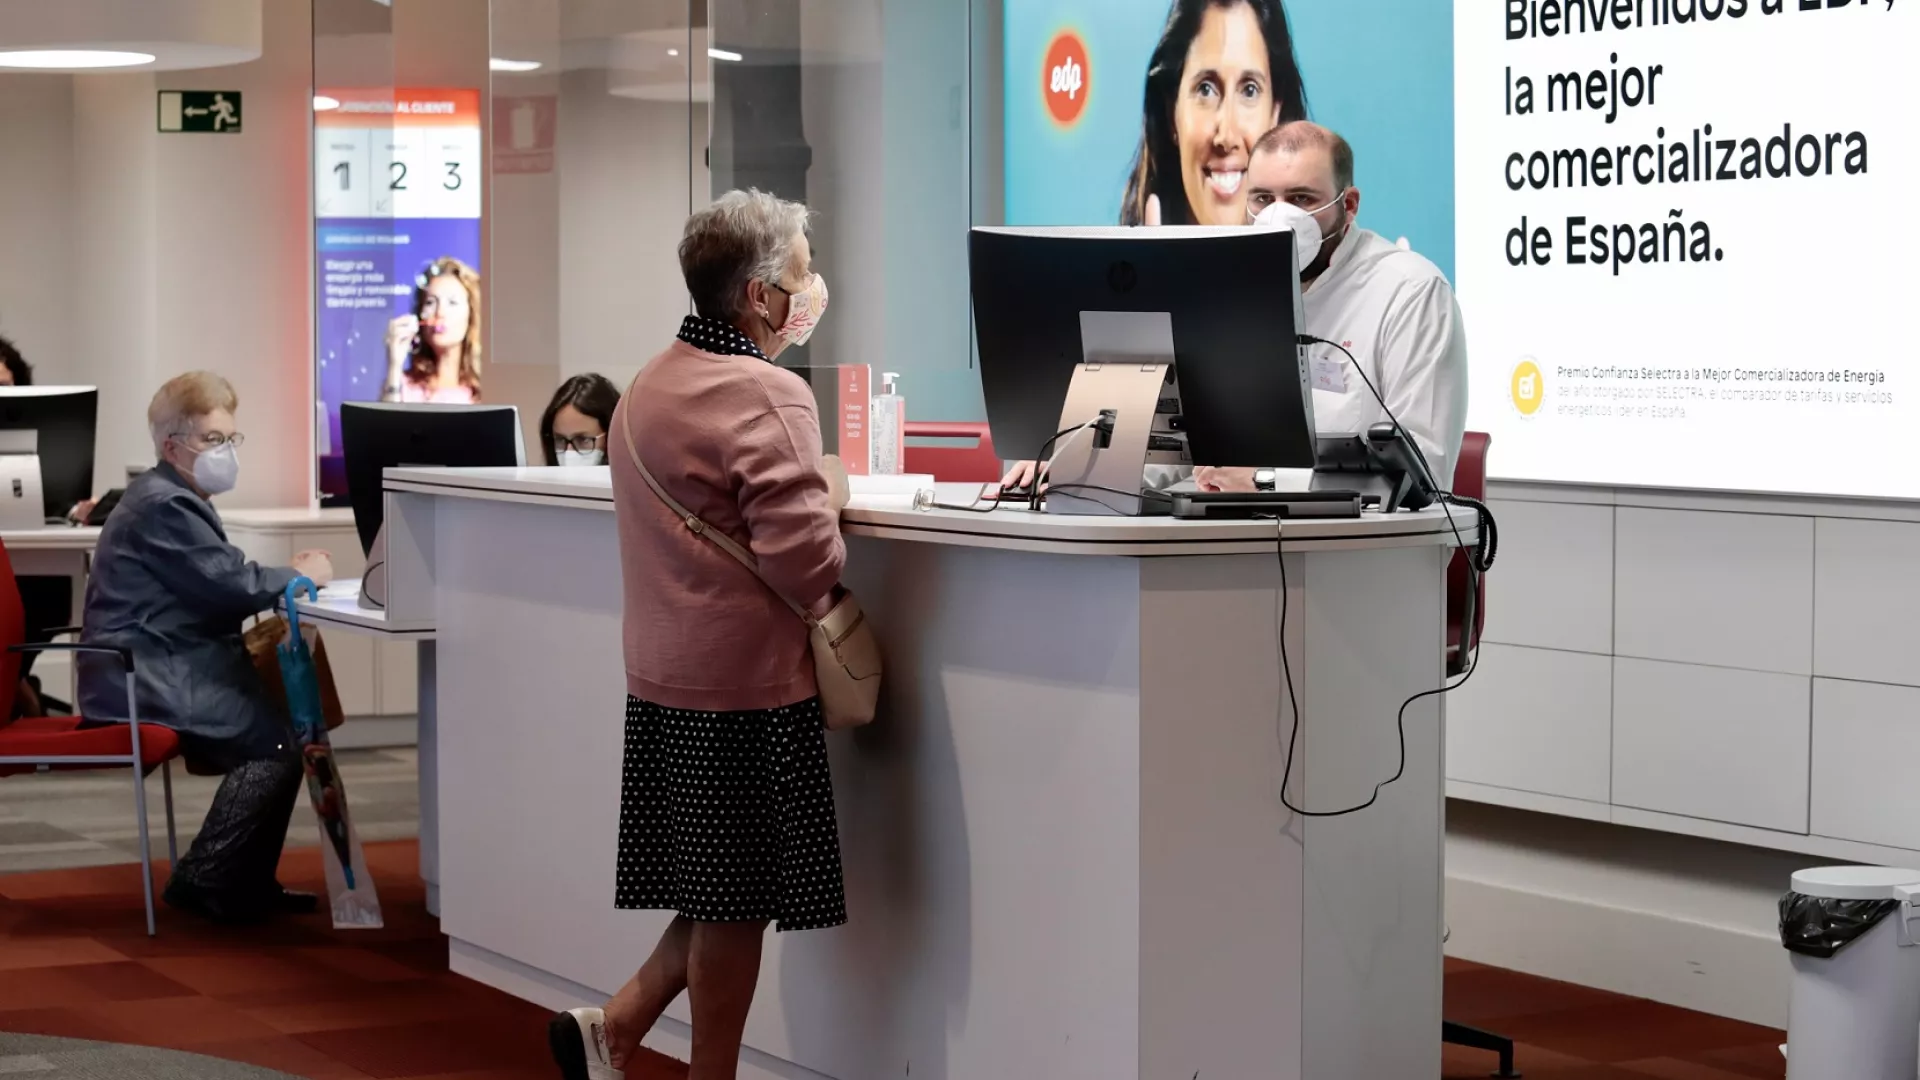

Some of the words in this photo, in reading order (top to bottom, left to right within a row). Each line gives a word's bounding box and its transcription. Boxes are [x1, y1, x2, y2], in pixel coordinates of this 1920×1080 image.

[1050, 55, 1082, 101] edp
[1506, 66, 1534, 116] la
[1547, 51, 1664, 124] mejor
[1505, 122, 1868, 191] comercializadora
[333, 161, 351, 191] 1
[388, 161, 407, 191] 2
[443, 161, 462, 191] 3
[1505, 215, 1552, 266] de
[1566, 208, 1724, 276] España.
[1557, 365, 1590, 378] Premio
[1592, 365, 1639, 379] Confianza
[1641, 366, 1682, 380] Selectra
[1683, 369, 1690, 380] a
[1691, 367, 1700, 380] la
[1702, 367, 1731, 383] Mejor
[1734, 367, 1825, 381] Comercializadora
[1827, 368, 1841, 382] de
[1844, 389, 1893, 404] servicios
